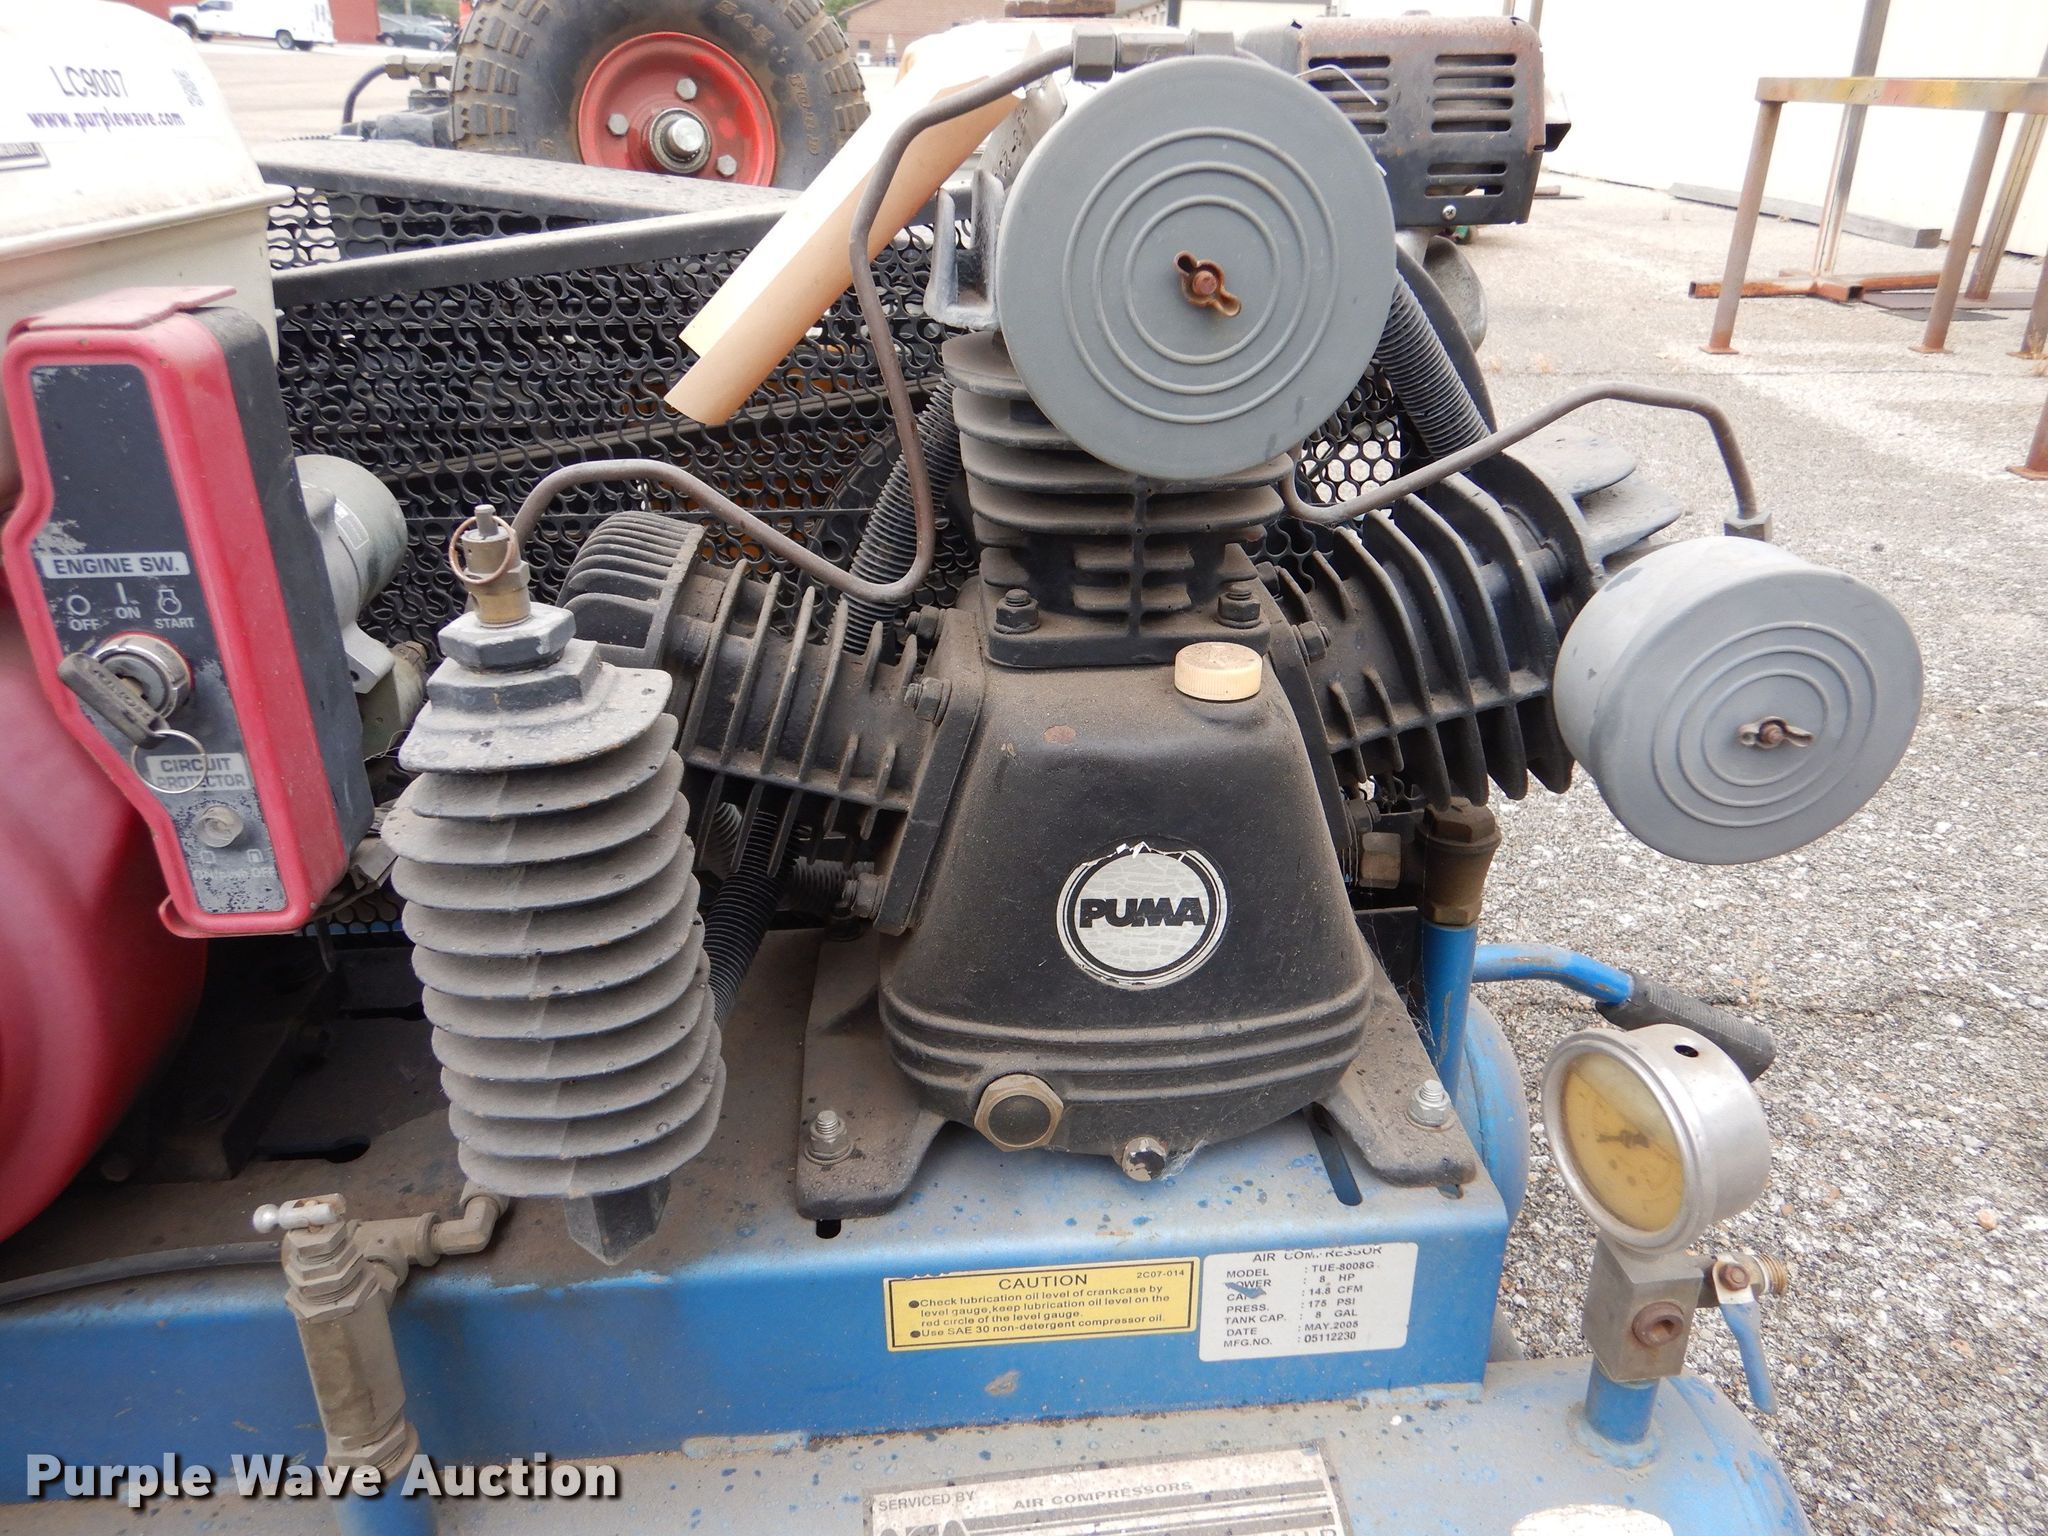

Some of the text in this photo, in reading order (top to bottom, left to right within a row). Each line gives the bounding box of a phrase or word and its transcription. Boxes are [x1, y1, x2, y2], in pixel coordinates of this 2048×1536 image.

[49, 65, 128, 98] LC9007
[27, 106, 185, 133] www.purplewave.com
[54, 555, 181, 575] ENGINE SW.
[115, 606, 141, 619] ON
[69, 618, 100, 631] OFF
[154, 617, 195, 629] START
[160, 757, 232, 773] CIRCUIT
[156, 774, 246, 789] PROTECTOR
[1079, 896, 1207, 929] PUMA
[1252, 1247, 1383, 1263] AIR COMRESSOR
[1136, 1269, 1185, 1279] 2C07-014
[1226, 1268, 1270, 1278] MODEL
[1229, 1273, 1355, 1288] OWER 8 HP
[998, 1273, 1088, 1290] CAUTION
[920, 1285, 1163, 1307] Check lubrication oil level of crankcase by
[1309, 1287, 1331, 1296] 14.8
[1337, 1285, 1363, 1294] CFM
[921, 1308, 949, 1317] level
[1024, 1300, 1085, 1310] lubrication
[1088, 1298, 1102, 1306] oil
[1105, 1296, 1132, 1305] level
[1226, 1297, 1355, 1314] PRESS. 175 PSI
[921, 1319, 940, 1327] red
[943, 1317, 975, 1326] circle
[991, 1314, 1010, 1323] the
[1013, 1312, 1041, 1321] level
[1043, 1311, 1083, 1321] gauge.
[1224, 1309, 1358, 1325] TANK CAP. 8 GAL
[921, 1329, 944, 1337] Use
[947, 1326, 972, 1335] SAE
[975, 1325, 990, 1333] 30
[992, 1320, 1076, 1332] non-detergent
[1078, 1316, 1145, 1327] compressor
[1226, 1320, 1359, 1337] DATE MAY.2005
[1223, 1331, 1357, 1348] MFG.NO. 05112230
[878, 1481, 1193, 1512] SERVICED BY AIR COMPRESSORS
